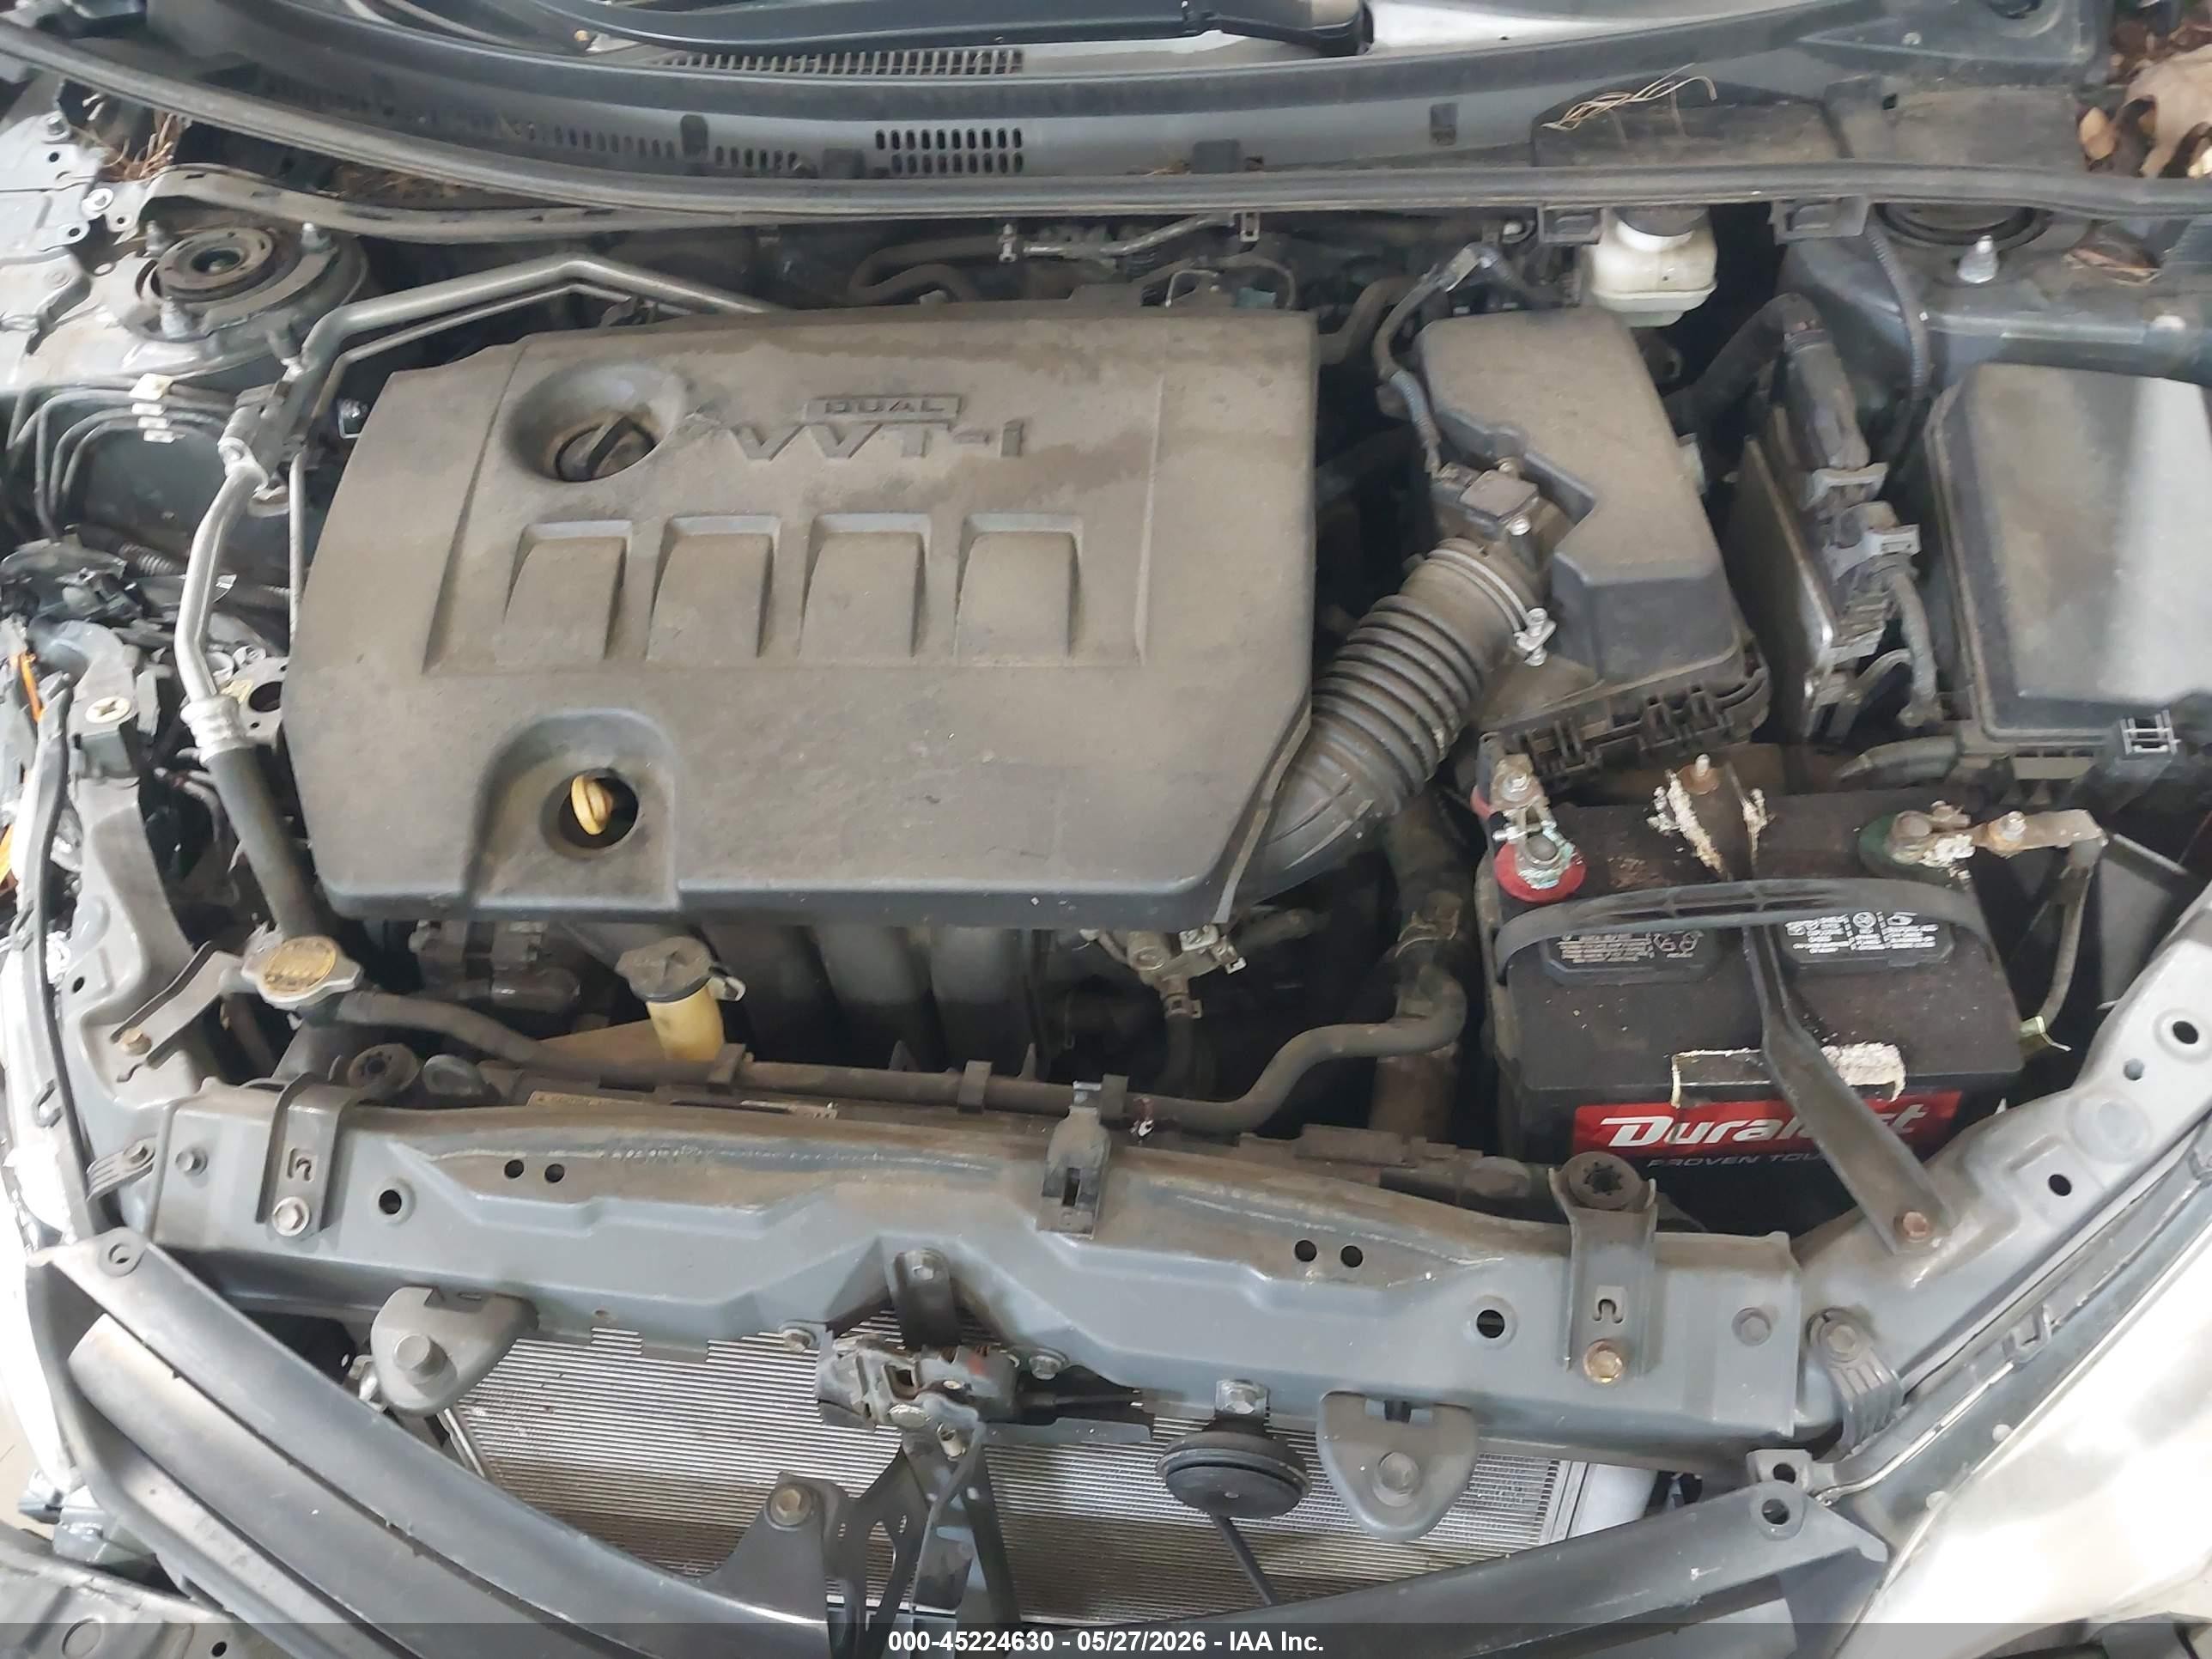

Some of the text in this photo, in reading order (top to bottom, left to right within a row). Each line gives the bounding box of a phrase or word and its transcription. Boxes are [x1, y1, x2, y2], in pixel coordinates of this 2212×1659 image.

[824, 398, 945, 415] DUAL
[1600, 1104, 1928, 1147] Duralt
[1647, 1154, 1760, 1169] PROVEN
